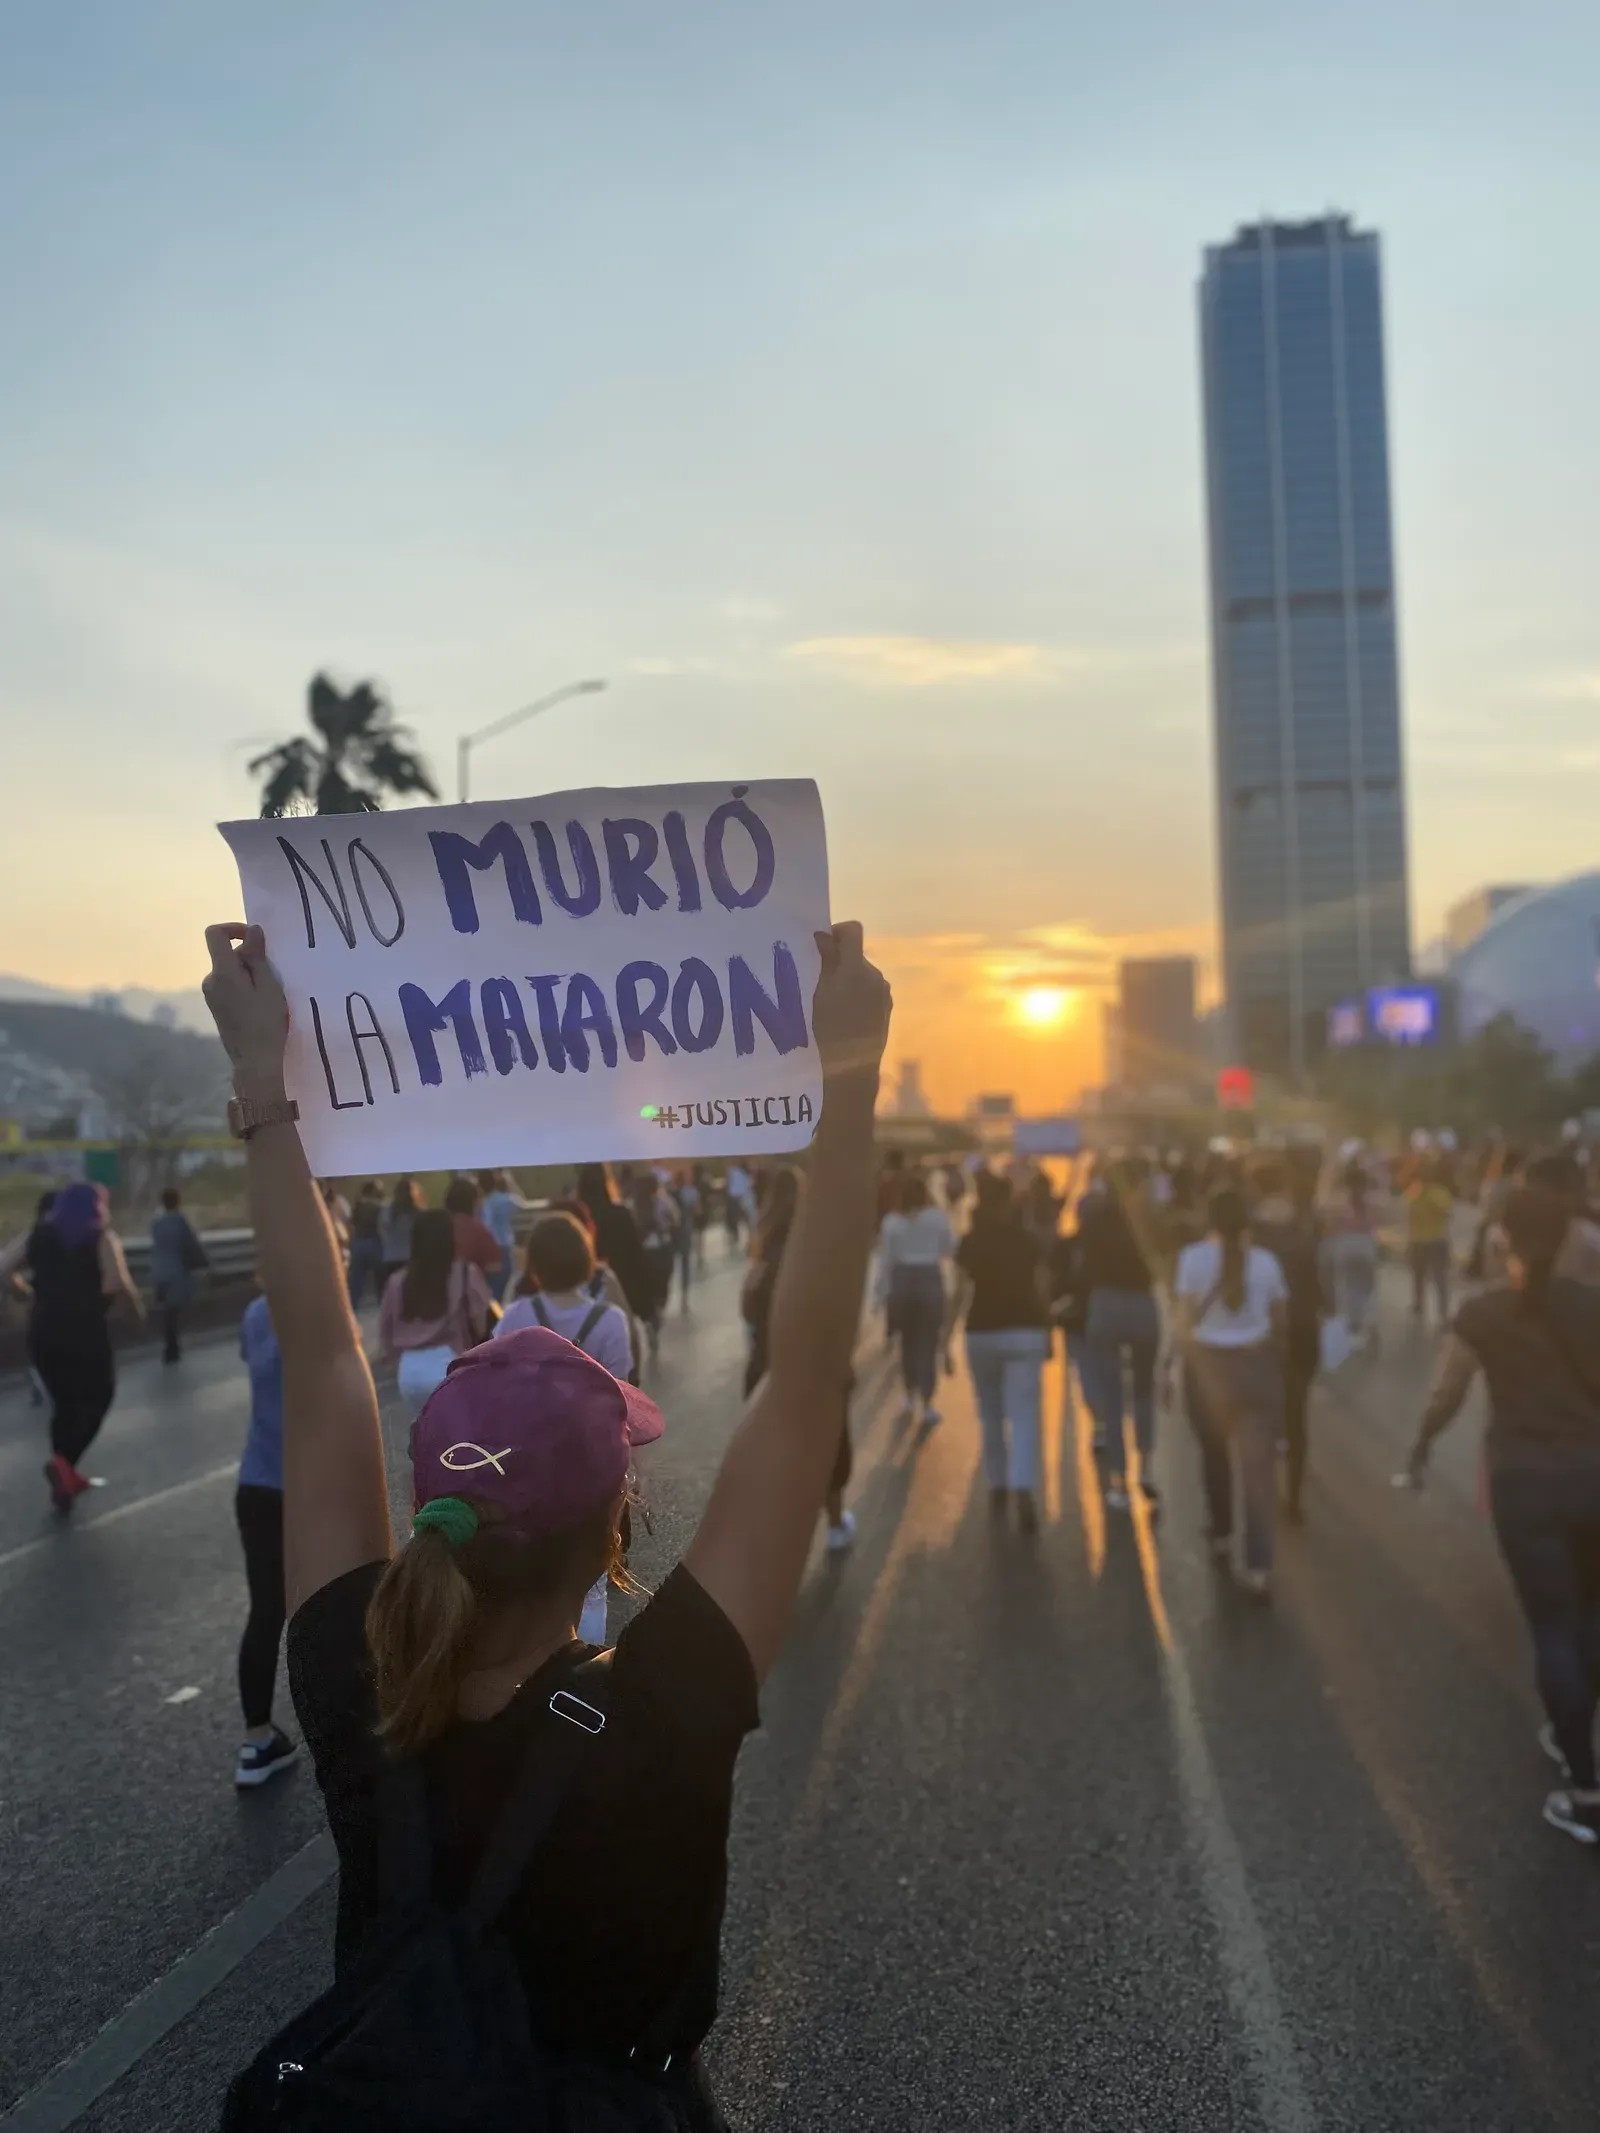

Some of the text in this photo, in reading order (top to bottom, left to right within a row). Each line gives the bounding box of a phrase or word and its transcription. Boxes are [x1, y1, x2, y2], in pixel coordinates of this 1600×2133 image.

[276, 785, 776, 949] NO MURIÓ
[309, 940, 810, 1110] LA MATARON
[651, 1093, 814, 1129] #JUSTICIA
